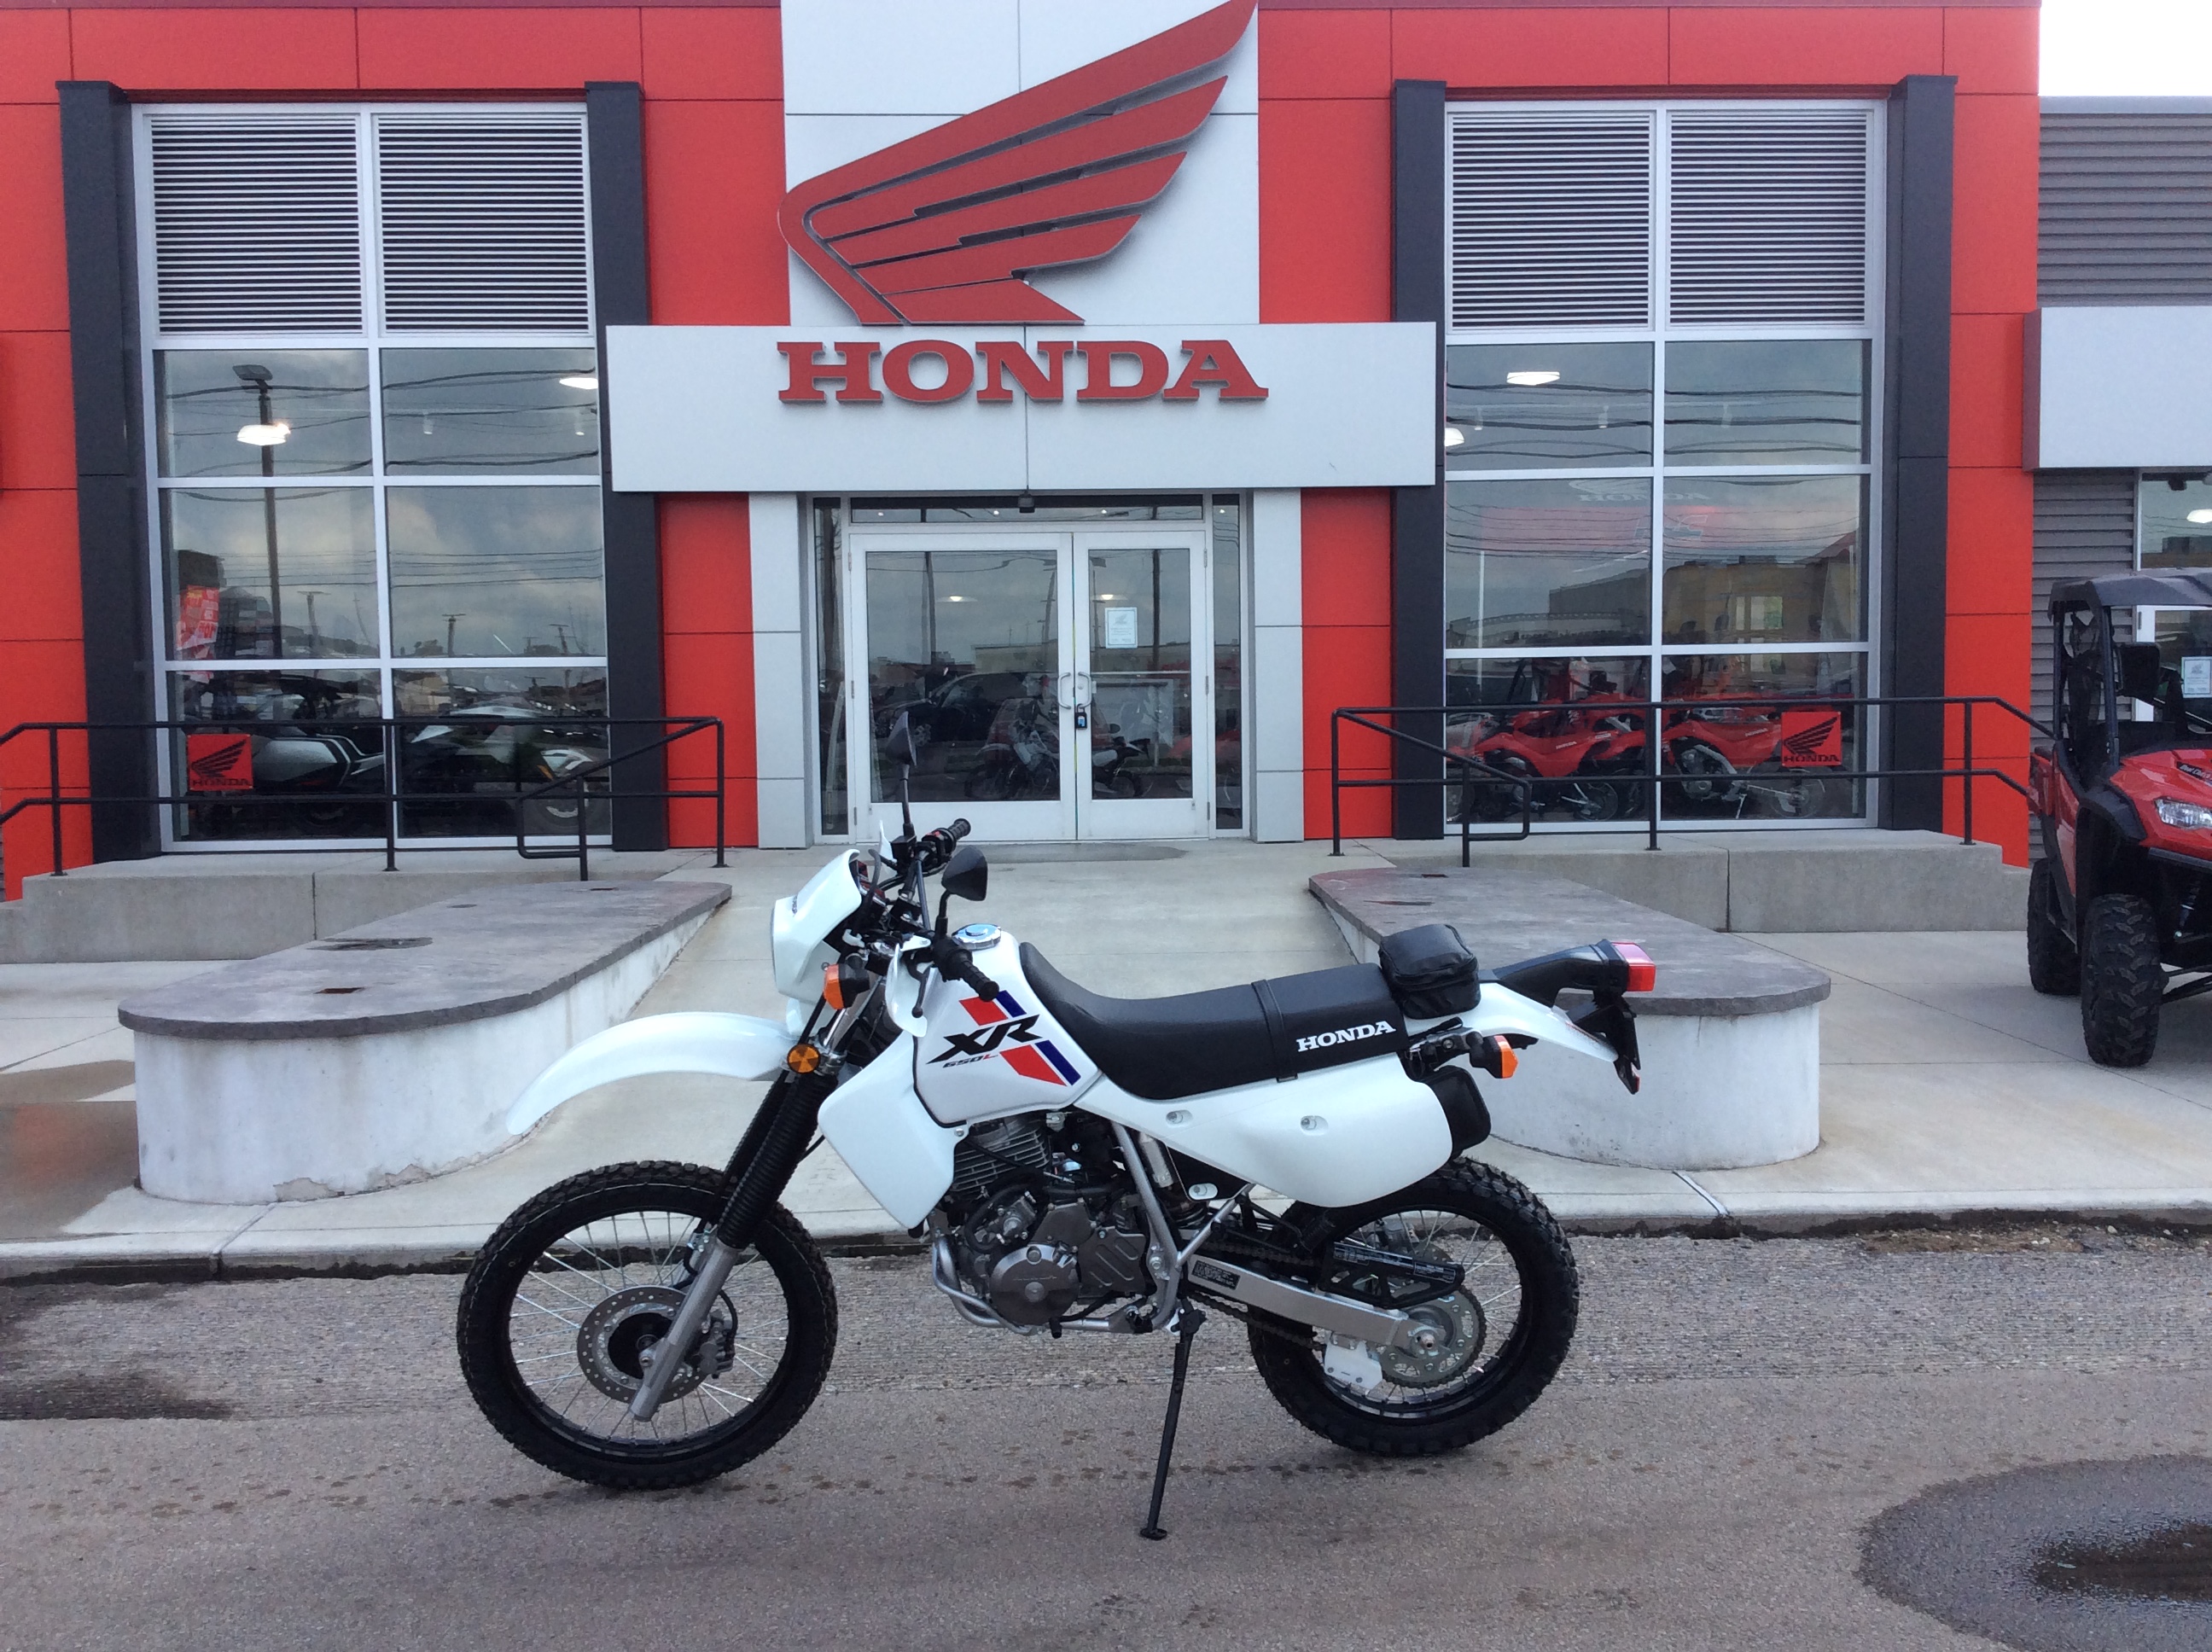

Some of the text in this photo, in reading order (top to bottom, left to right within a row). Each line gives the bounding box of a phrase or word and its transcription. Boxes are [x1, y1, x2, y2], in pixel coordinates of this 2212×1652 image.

[777, 339, 1269, 403] HONDA
[926, 1014, 1043, 1064] XR
[1296, 1021, 1396, 1052] HONDA
